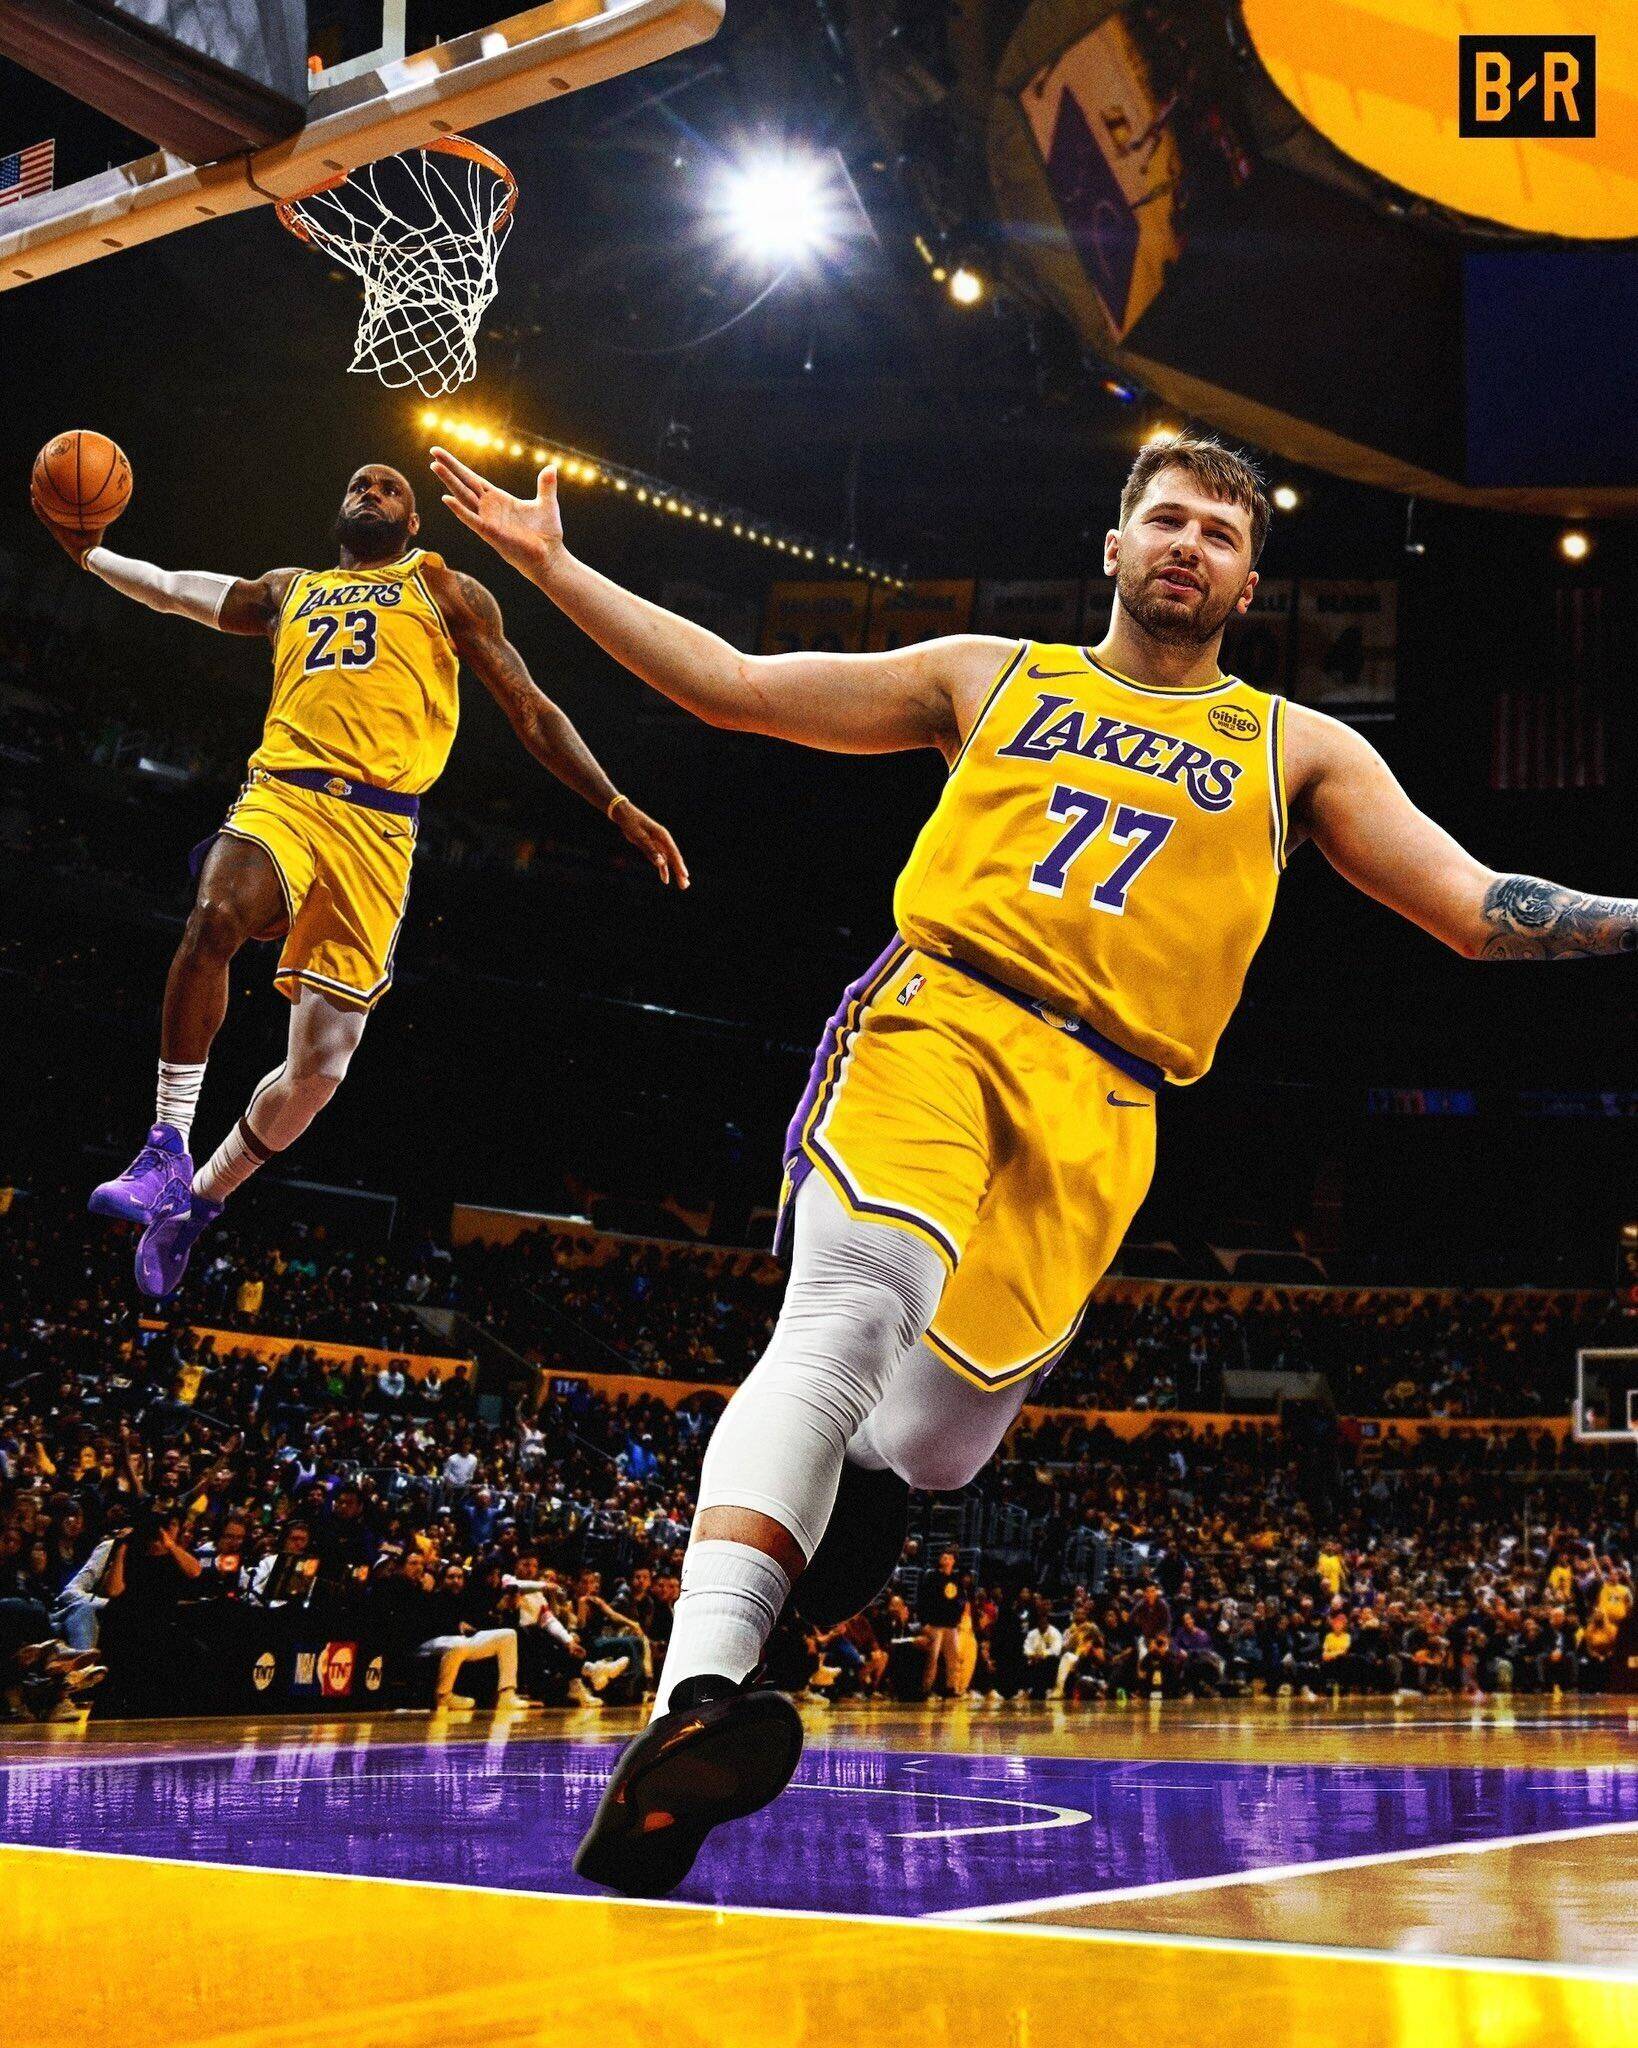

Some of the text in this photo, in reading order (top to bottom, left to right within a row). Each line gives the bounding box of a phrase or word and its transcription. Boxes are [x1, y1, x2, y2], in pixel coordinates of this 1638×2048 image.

[292, 582, 403, 622] LAKERS
[304, 609, 378, 675] 23
[1212, 709, 1258, 733] bibigo
[997, 694, 1243, 812] LAKERS
[1029, 783, 1177, 915] 77
[328, 1661, 353, 1680] TNT
